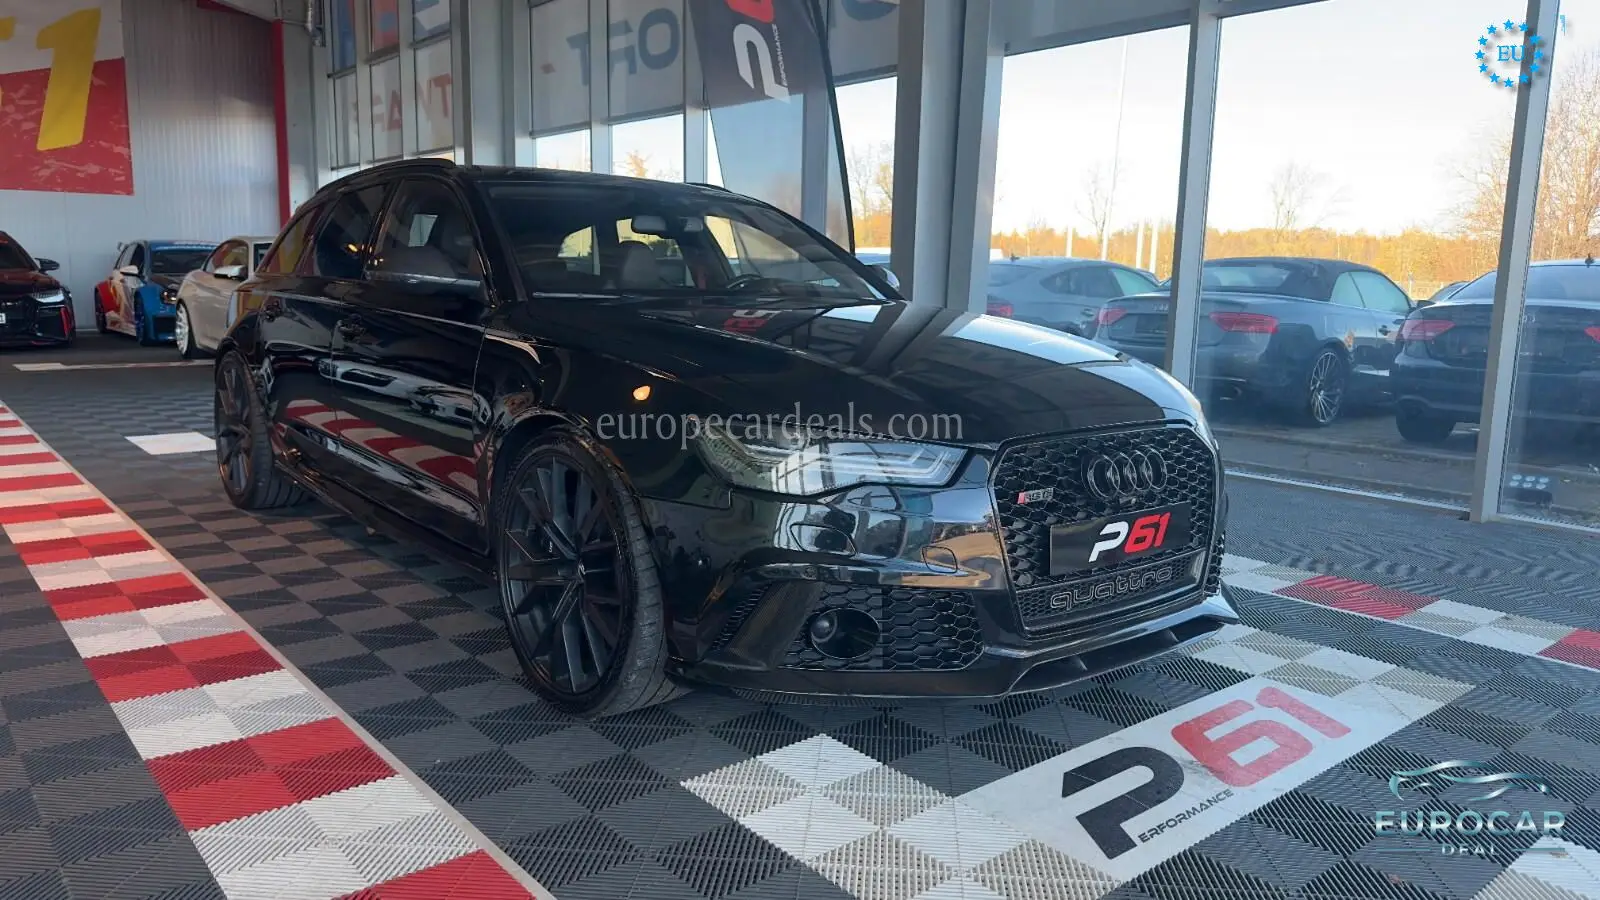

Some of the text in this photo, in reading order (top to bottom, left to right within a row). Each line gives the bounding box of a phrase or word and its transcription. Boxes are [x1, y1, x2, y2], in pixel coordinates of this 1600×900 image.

[0, 8, 102, 151] 1
[1088, 511, 1172, 563] P61
[1050, 566, 1173, 611] quattro
[1061, 686, 1352, 860] P61
